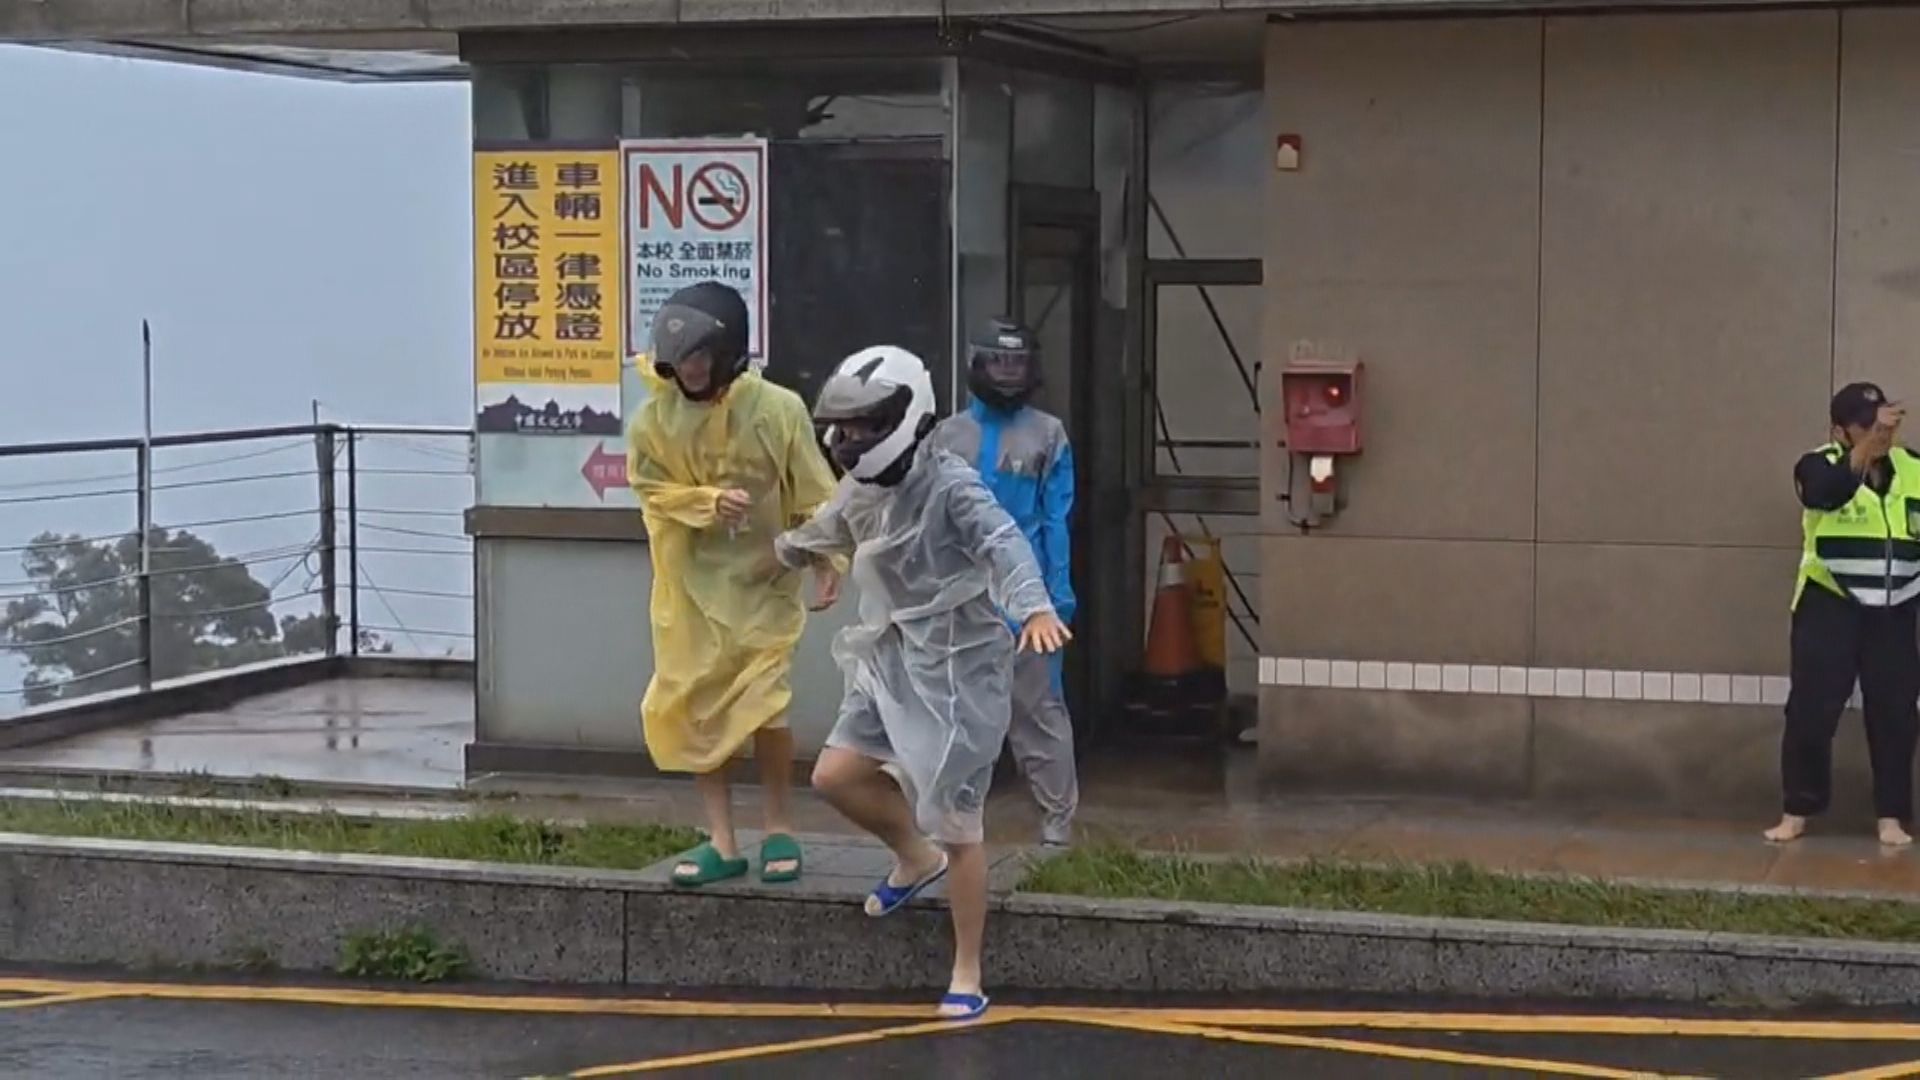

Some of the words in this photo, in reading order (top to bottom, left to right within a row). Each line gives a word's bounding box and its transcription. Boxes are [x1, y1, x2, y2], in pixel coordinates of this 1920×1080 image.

[492, 161, 540, 340] 進入校區停放
[554, 161, 602, 340] 車輛一律憑證
[637, 242, 674, 260] 本校
[637, 263, 663, 278] No
[669, 263, 751, 280] Smoking
